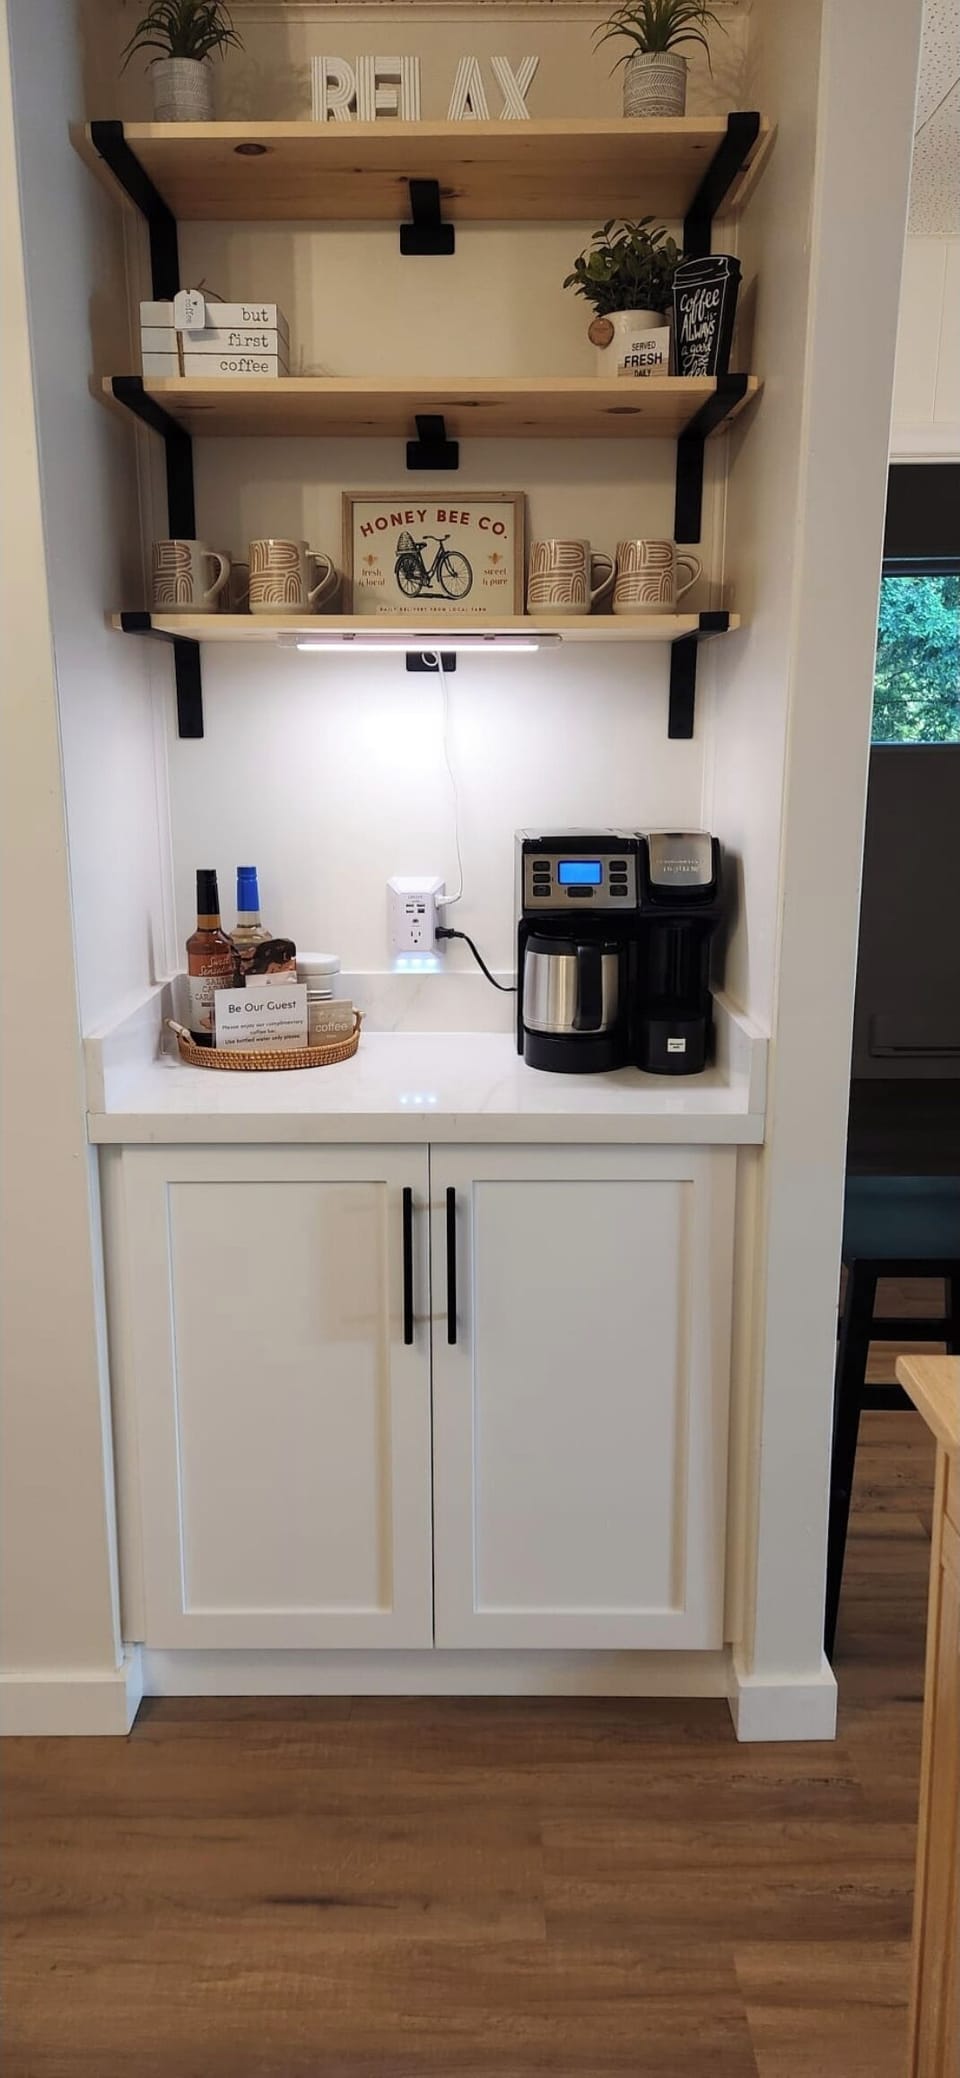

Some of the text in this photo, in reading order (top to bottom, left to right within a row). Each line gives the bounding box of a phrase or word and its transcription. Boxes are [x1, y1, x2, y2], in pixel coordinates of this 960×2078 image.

[680, 288, 720, 324] Coffee
[242, 308, 269, 322] but
[228, 333, 269, 347] first
[631, 341, 657, 352] SERVED
[681, 345, 688, 356] a
[220, 358, 269, 372] coffee
[624, 352, 663, 368] FRESH
[634, 369, 652, 377] DAILY
[360, 509, 507, 540] HONEY BEE CO.
[228, 1001, 296, 1013] Be Our Guest
[315, 1021, 348, 1033] coffee
